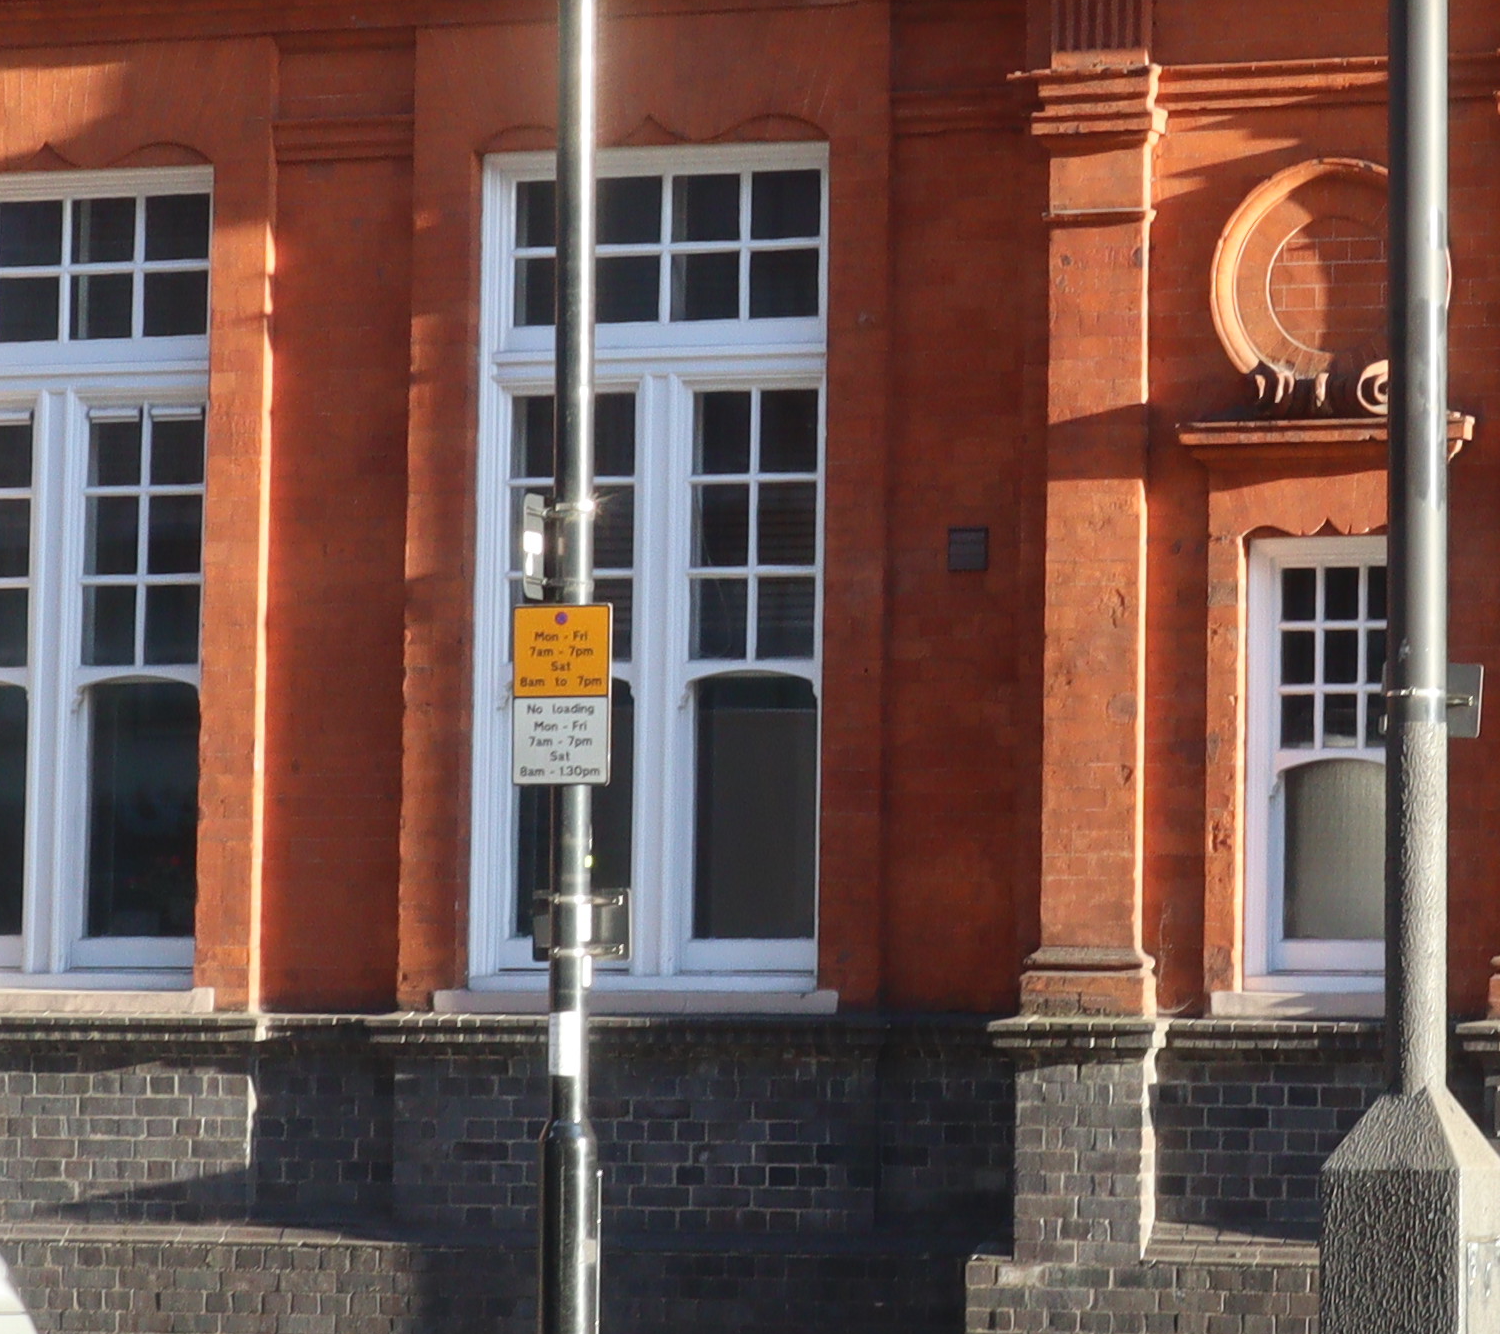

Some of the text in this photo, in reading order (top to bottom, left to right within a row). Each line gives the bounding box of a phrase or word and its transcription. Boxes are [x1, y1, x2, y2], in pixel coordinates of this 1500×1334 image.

[533, 631, 559, 642] Mon
[572, 630, 588, 641] Fri
[529, 646, 554, 657] 7am
[569, 646, 594, 658] 7pm
[550, 661, 571, 672] Sat
[519, 675, 603, 688] 8am to 7pm
[526, 703, 595, 716] No loading
[533, 721, 558, 732] Mon
[571, 720, 587, 731] Fri
[528, 736, 553, 747] 7am
[567, 735, 593, 749] 7pm
[549, 750, 570, 762] Sat
[519, 766, 545, 777] 8am
